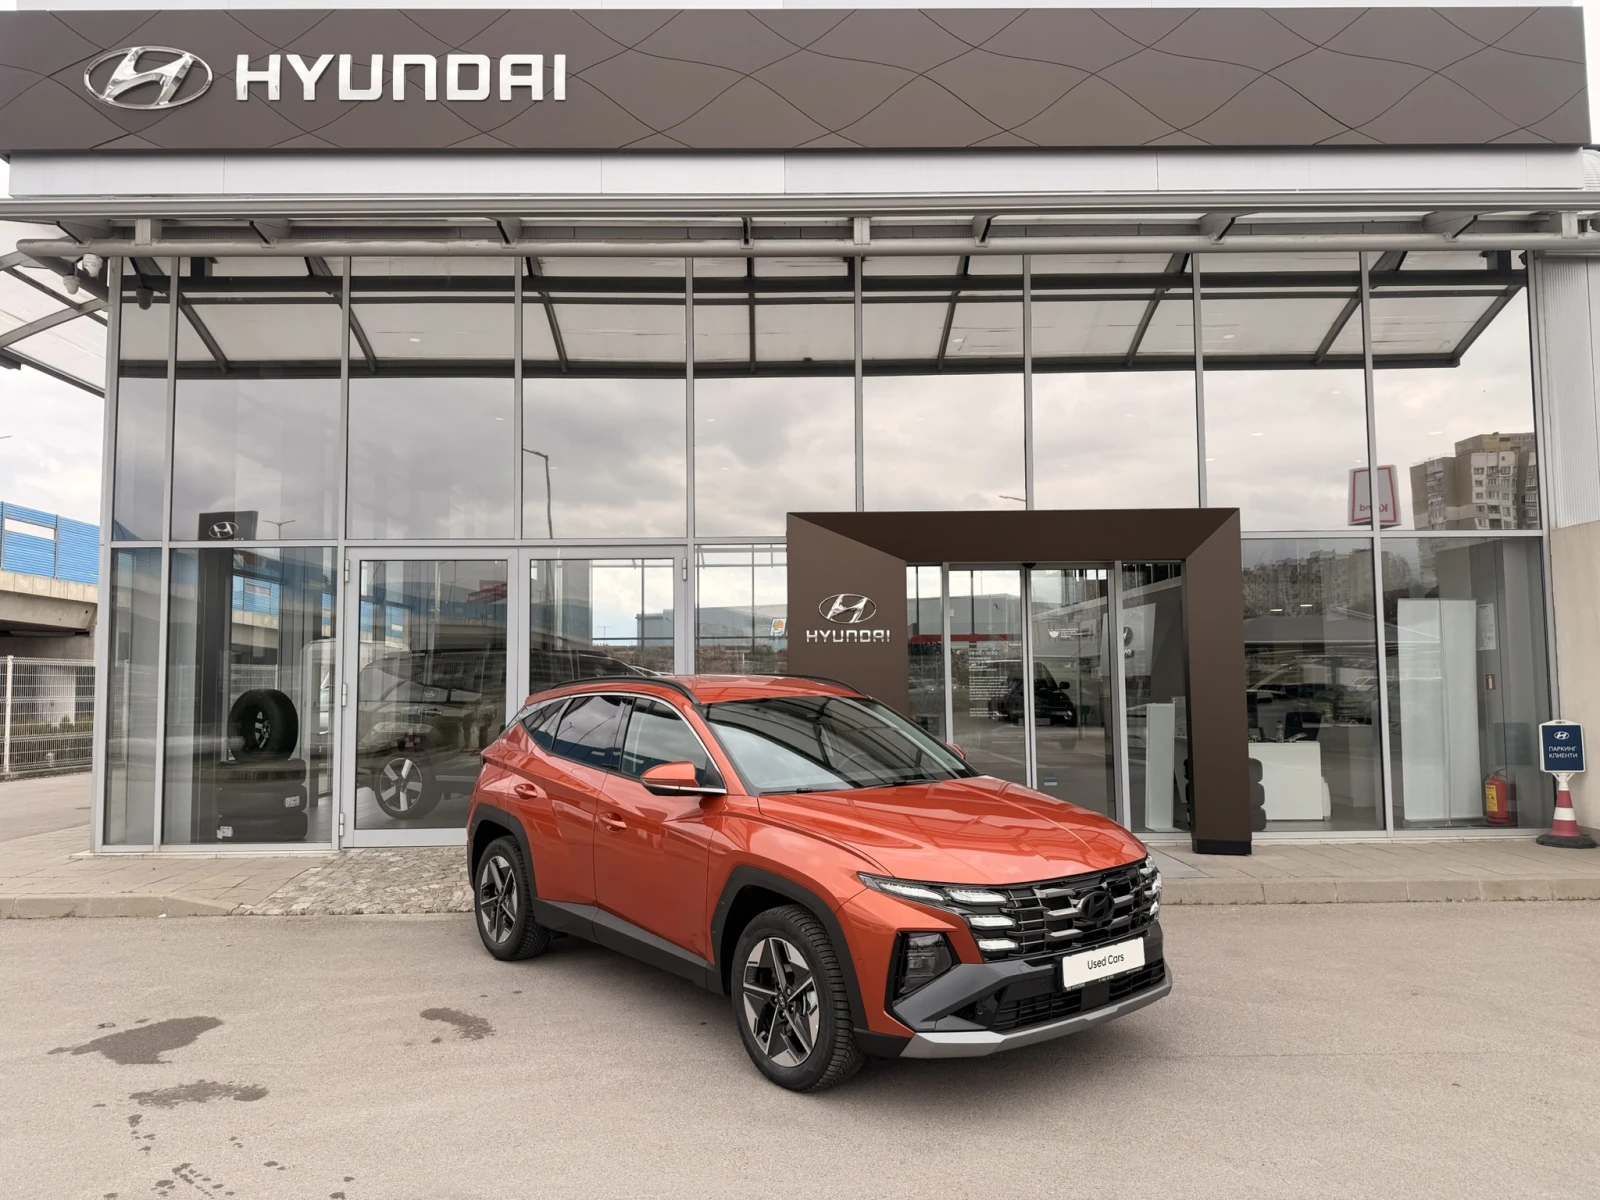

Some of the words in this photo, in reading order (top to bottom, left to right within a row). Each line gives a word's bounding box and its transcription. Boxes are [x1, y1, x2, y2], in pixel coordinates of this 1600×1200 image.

[235, 53, 566, 102] HYUNDAI
[805, 629, 891, 643] HYUNDAI
[1087, 956, 1107, 970] Used
[1107, 953, 1125, 965] Cars
